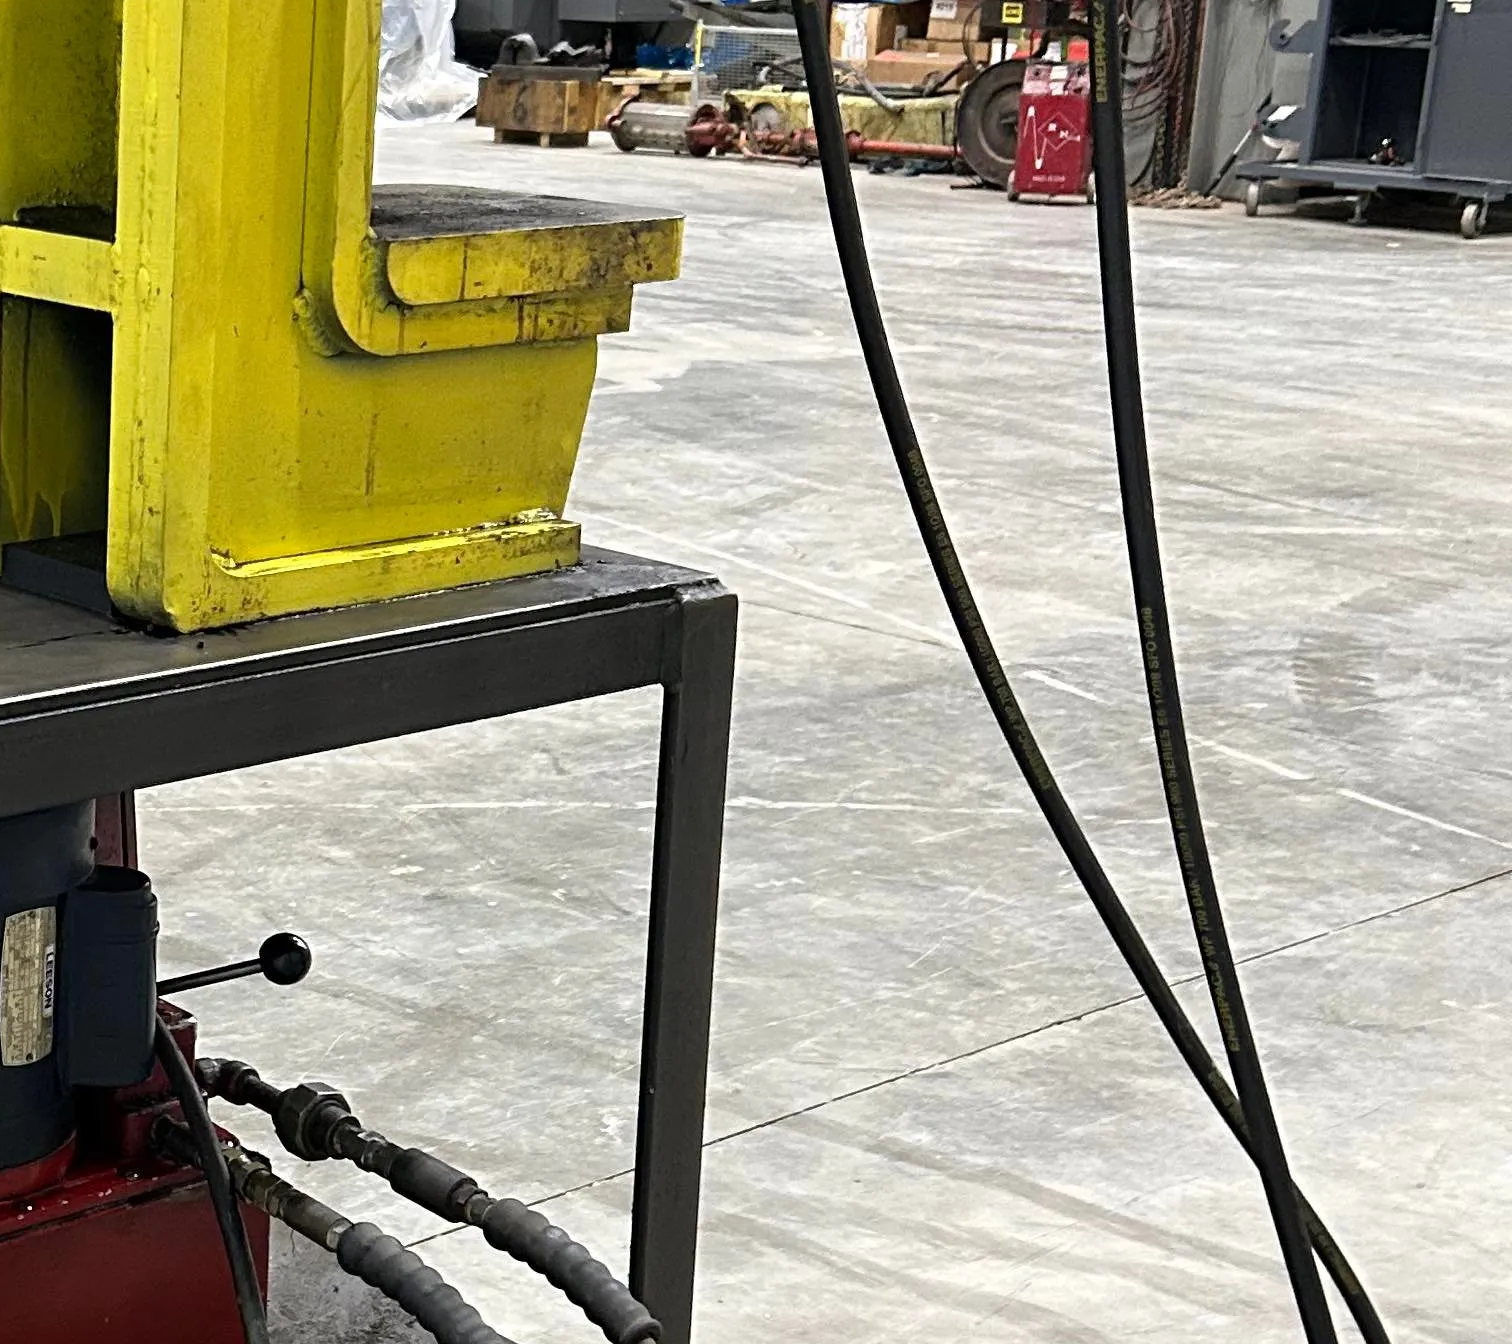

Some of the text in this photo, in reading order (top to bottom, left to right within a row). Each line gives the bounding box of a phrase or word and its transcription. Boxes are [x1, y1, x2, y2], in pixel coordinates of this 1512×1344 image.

[1144, 640, 1161, 670] SFO
[1157, 728, 1179, 779] SERIES
[1187, 877, 1205, 907] BAR
[1194, 908, 1211, 932] 700
[1200, 933, 1217, 957] WP
[45, 951, 55, 1009] LEESON
